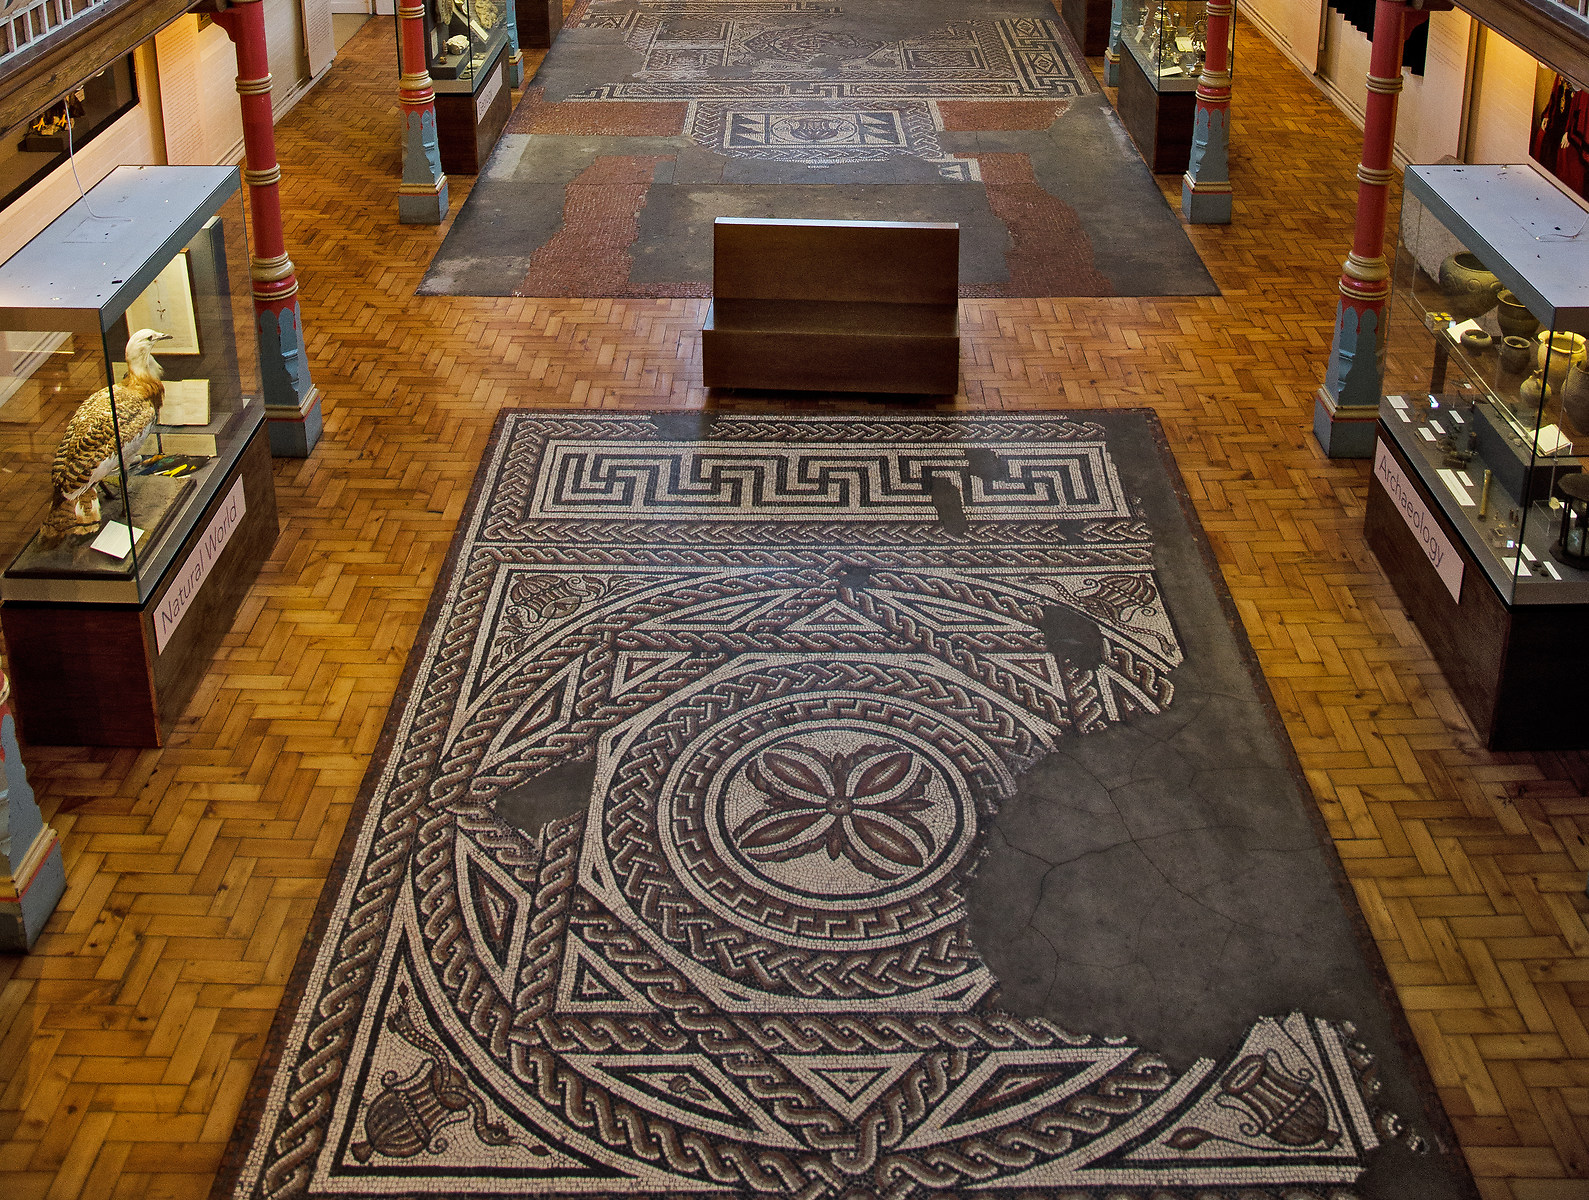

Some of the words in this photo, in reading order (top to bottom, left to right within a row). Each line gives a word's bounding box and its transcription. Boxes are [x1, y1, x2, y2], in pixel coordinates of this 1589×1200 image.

[161, 550, 205, 634] Natural
[204, 496, 237, 560] World
[1379, 455, 1444, 568] Archaeology
